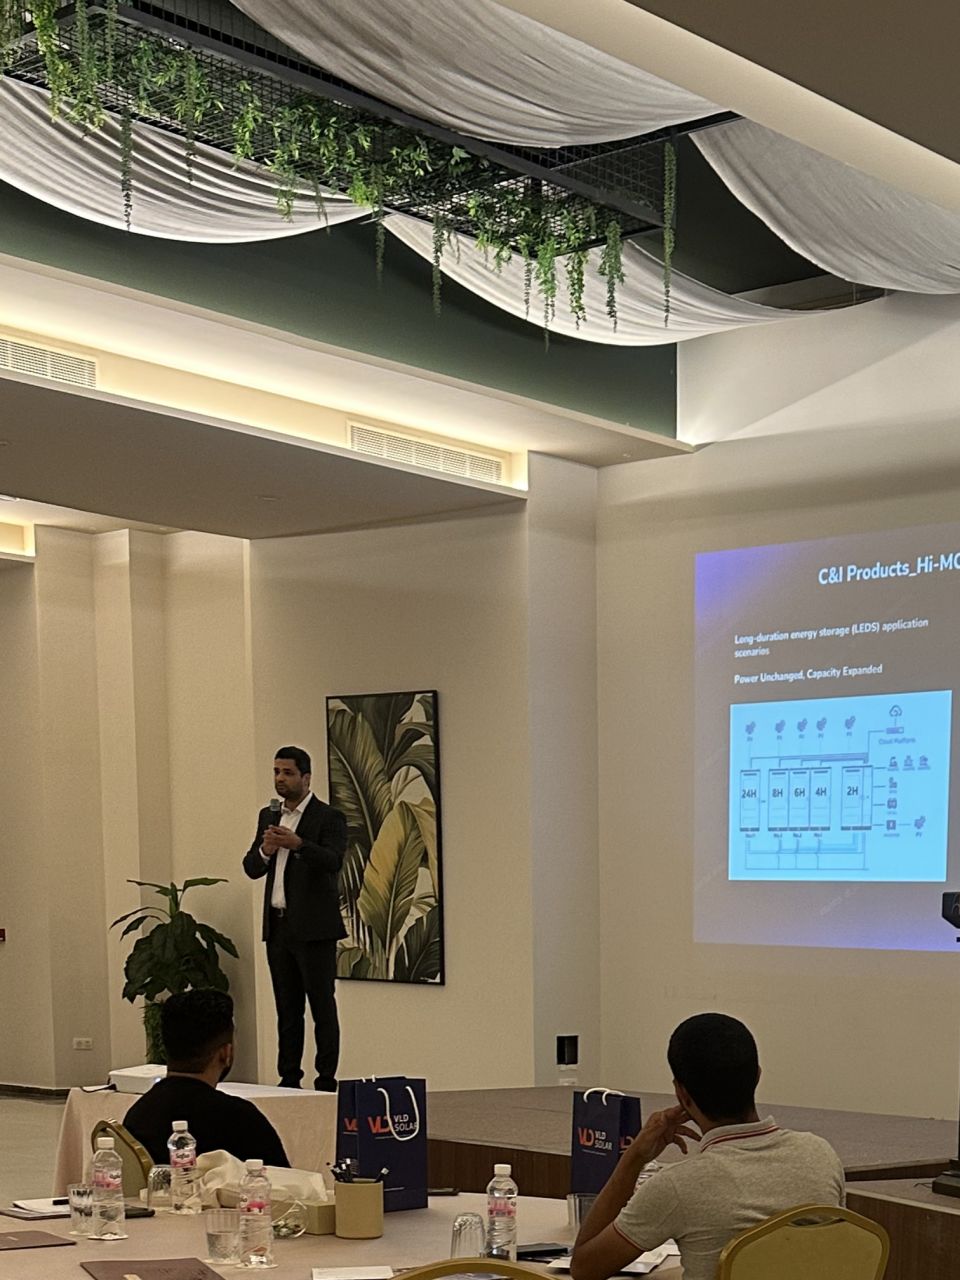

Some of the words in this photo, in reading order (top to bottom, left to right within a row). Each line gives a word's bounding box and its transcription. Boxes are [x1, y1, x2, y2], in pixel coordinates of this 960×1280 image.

[818, 567, 844, 585] C&I
[734, 630, 789, 645] Long-duration
[791, 629, 818, 640] energy
[819, 625, 850, 638] storage
[852, 621, 880, 636] (LEDS)
[882, 617, 929, 633] application
[734, 646, 770, 658] scenarios
[734, 673, 759, 685] Power
[760, 670, 805, 683] Unchanged,
[807, 667, 841, 680] Capacity
[843, 663, 883, 677] Expanded
[741, 789, 757, 799] 24H
[772, 788, 784, 798] 8H
[794, 787, 806, 798] 6H
[815, 786, 827, 797] 4H
[847, 786, 859, 796] 2H
